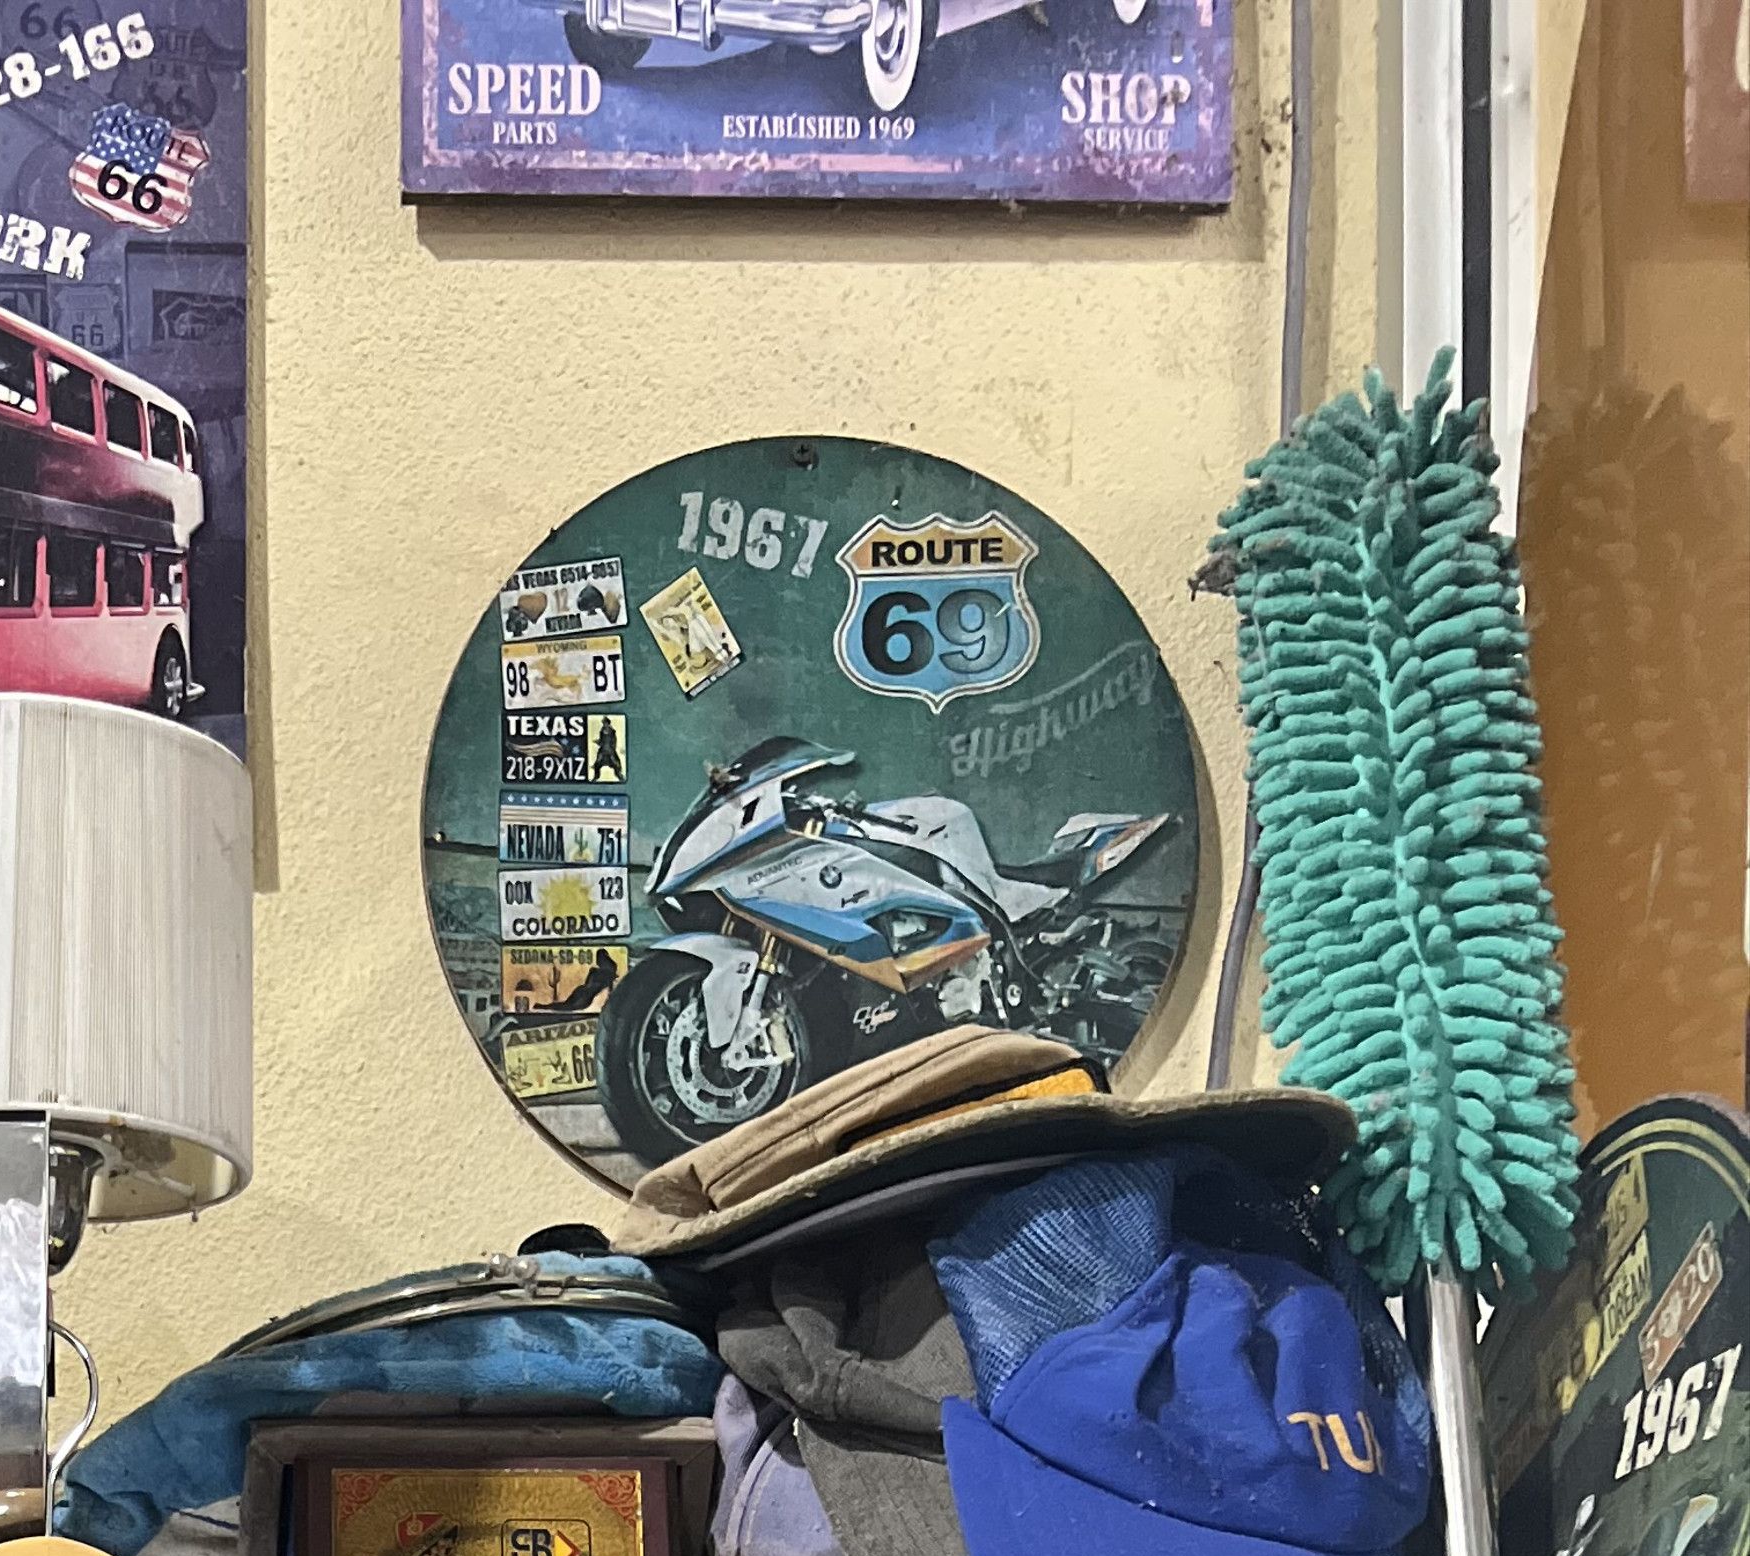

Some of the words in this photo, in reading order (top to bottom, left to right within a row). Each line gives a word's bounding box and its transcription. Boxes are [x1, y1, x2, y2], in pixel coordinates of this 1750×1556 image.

[448, 62, 602, 116] SPEED
[1061, 71, 1192, 126] SHOP
[492, 121, 558, 145] PARTS
[723, 112, 861, 140] ESTABLISHED
[868, 116, 915, 141] 1969
[1083, 126, 1170, 153] SERVICE
[99, 160, 168, 215] 66
[677, 491, 829, 580] 1967
[872, 537, 1005, 568] ROUTE
[536, 641, 588, 654] WYOMING
[861, 588, 1011, 677] 69
[506, 661, 530, 698] 98
[593, 654, 620, 692] BT
[507, 716, 585, 736] TEXAS
[951, 641, 1158, 778] Highway
[506, 756, 586, 780] 218-9X1Z
[507, 824, 566, 861] NEVADA
[597, 828, 623, 864] 751
[599, 876, 625, 900] 123
[512, 914, 619, 936] COLORADO
[1614, 1343, 1742, 1479] 1967
